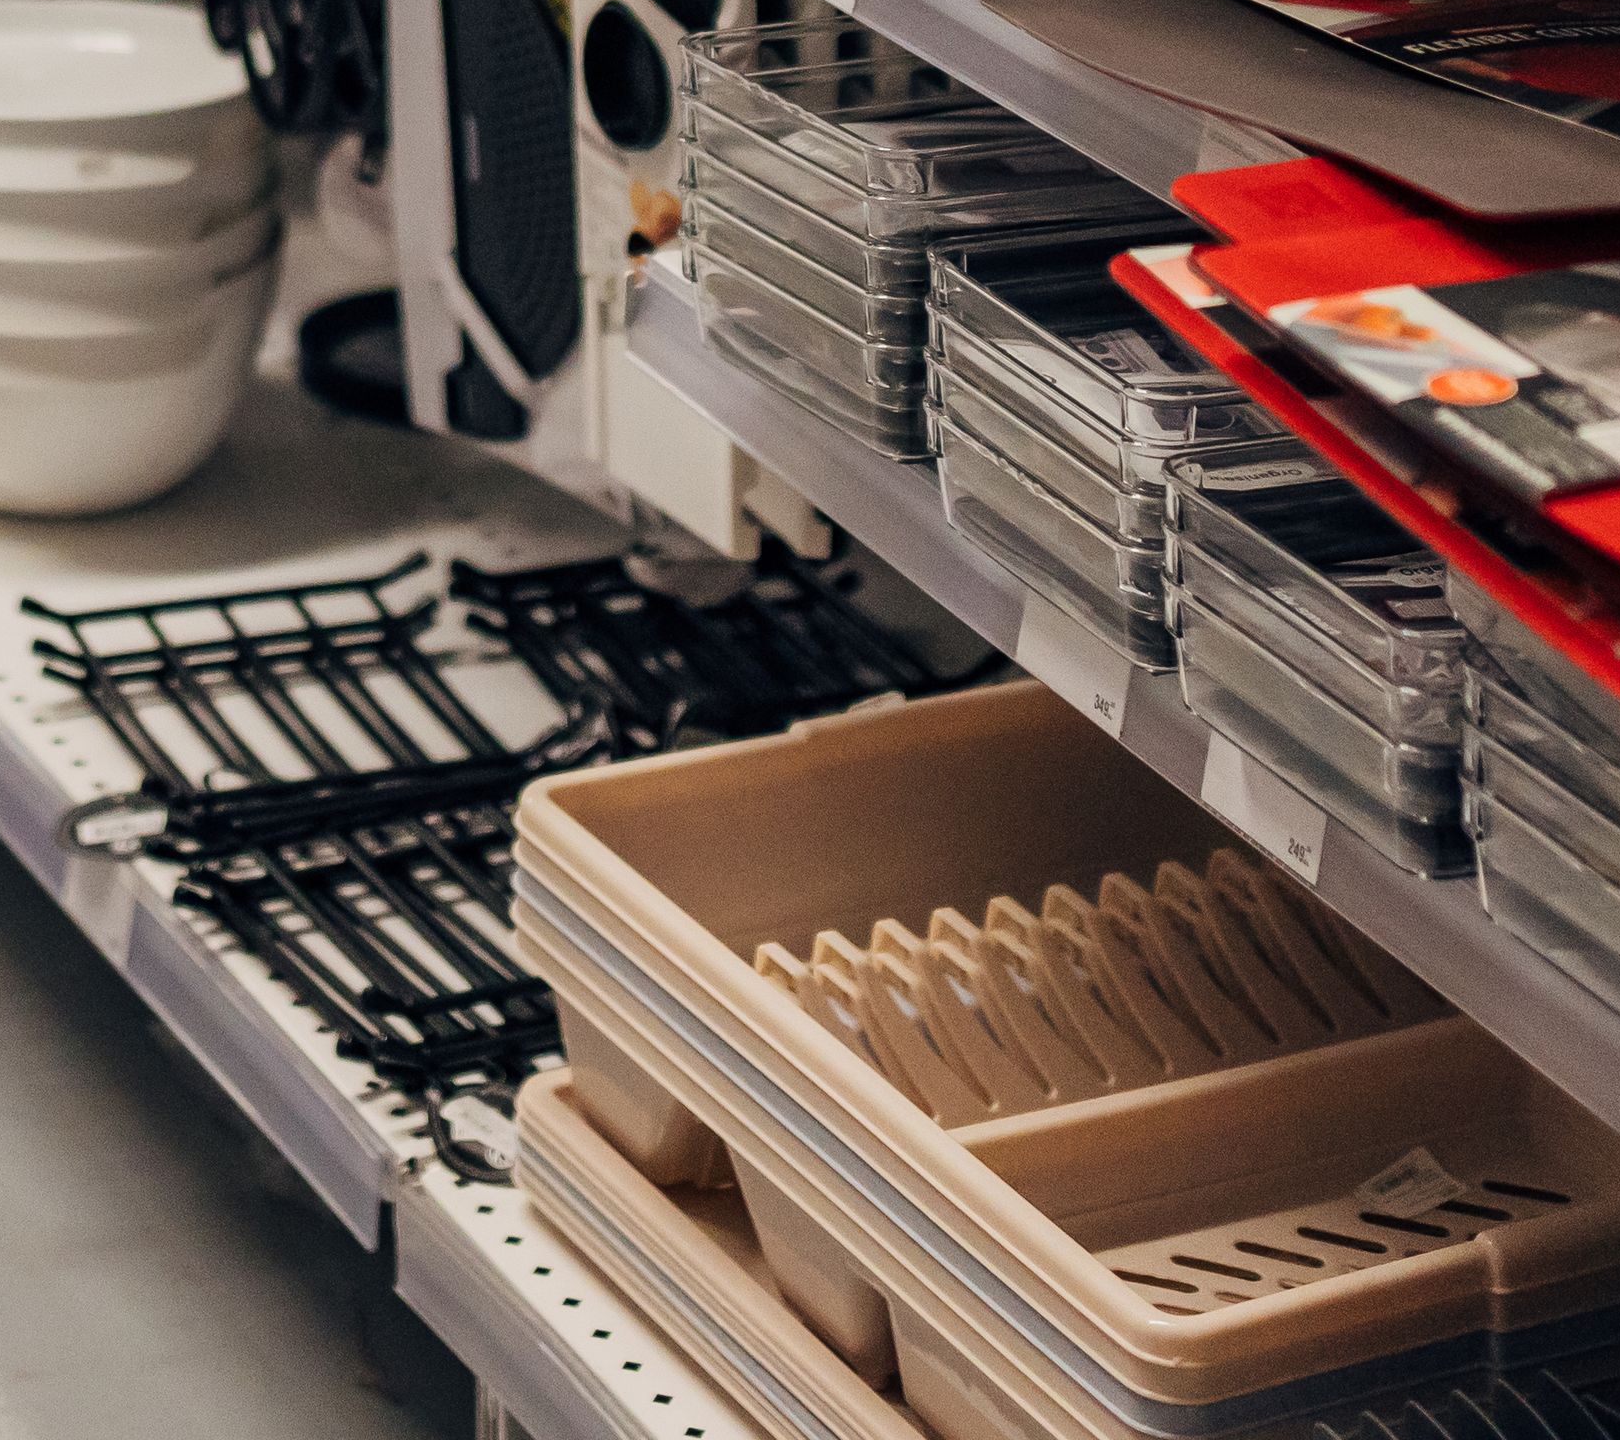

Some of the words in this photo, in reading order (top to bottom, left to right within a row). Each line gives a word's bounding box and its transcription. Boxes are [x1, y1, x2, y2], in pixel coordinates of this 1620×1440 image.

[1402, 27, 1534, 57] FLEXIBLE
[1094, 693, 1111, 720] 349
[1287, 837, 1305, 863] 249
